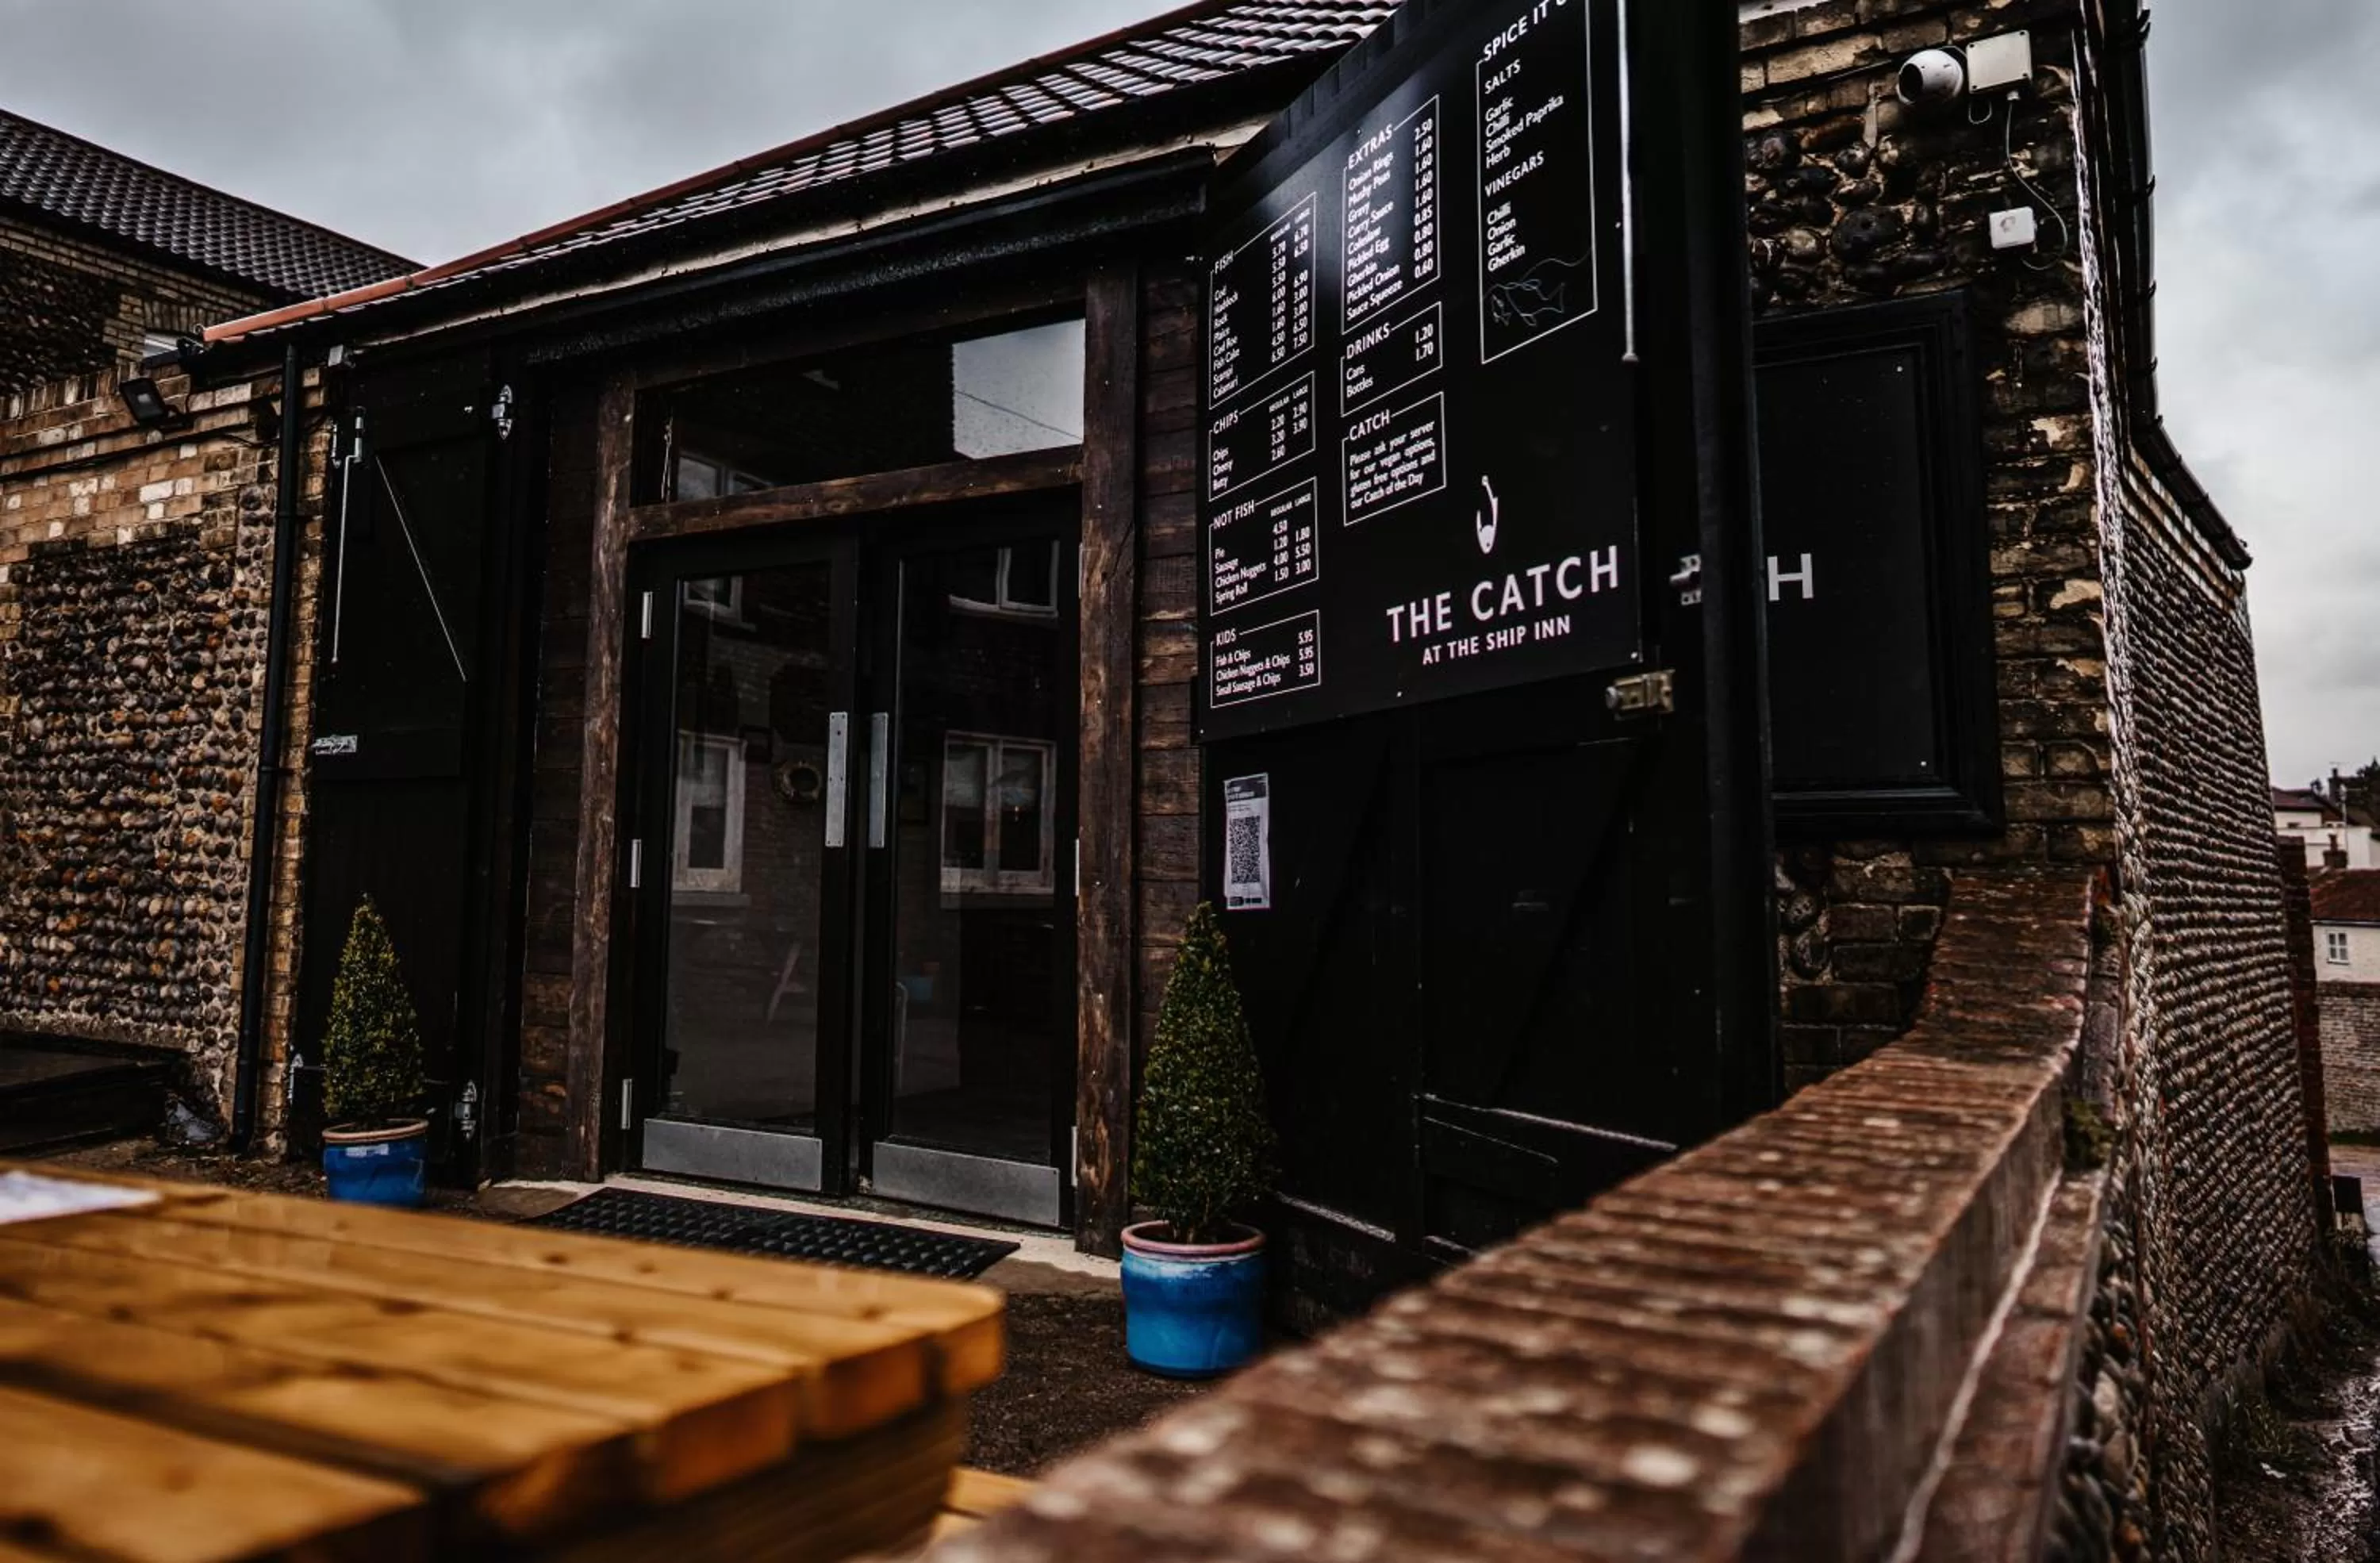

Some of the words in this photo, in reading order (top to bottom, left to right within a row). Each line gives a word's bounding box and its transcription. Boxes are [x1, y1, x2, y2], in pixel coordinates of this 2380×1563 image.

[1484, 15, 1528, 61] SPICE
[1533, 0, 1549, 25] IT
[1485, 59, 1520, 94] SALTS
[1485, 97, 1513, 122] Garlic
[1485, 113, 1509, 136] Chilli
[1486, 117, 1523, 153] Smoked
[1526, 95, 1564, 127] Paprika
[1348, 124, 1393, 170] EXTRAS
[1487, 144, 1511, 168] Herb
[1349, 168, 1372, 190] Onion
[1372, 152, 1393, 173] Rings
[1485, 151, 1544, 197] VINEGARS
[1349, 184, 1372, 208] Mushy
[1372, 171, 1390, 189] Peas
[1348, 217, 1369, 238] Curry
[1371, 202, 1393, 223] Sauce
[1349, 202, 1369, 222] Gravy
[1487, 202, 1511, 225] Chilli
[1348, 226, 1380, 255] Coleslaw
[1488, 219, 1515, 240] Onion
[1347, 244, 1374, 271] Pickled
[1376, 237, 1389, 253] Egg
[1488, 234, 1515, 255] Garlic
[1488, 245, 1525, 271] Gherkin
[1215, 249, 1234, 275] FISH
[1347, 262, 1377, 287] Gherkin
[1347, 278, 1373, 303] Pickled
[1375, 265, 1399, 286] Onion
[1347, 301, 1368, 321] Sauce
[1369, 280, 1403, 306] Squeeze
[1214, 341, 1225, 356] Cod
[1346, 323, 1390, 359] DRINKS
[1346, 365, 1365, 380] Cans
[1347, 377, 1372, 397] Bottles
[1213, 409, 1238, 435] CHIPS
[1349, 409, 1390, 441] CATCH
[1213, 447, 1228, 462] Chips
[1350, 451, 1371, 467] Please
[1374, 441, 1386, 455] ask
[1390, 434, 1407, 452] your
[1411, 421, 1434, 439] server
[1350, 470, 1361, 481] for
[1364, 463, 1376, 474] our
[1380, 452, 1401, 467] vegan
[1350, 479, 1371, 498] gluten
[1374, 473, 1388, 485] free
[1389, 460, 1418, 480] options
[1421, 449, 1435, 465] and
[1350, 497, 1363, 509] our
[1365, 487, 1384, 503] Catch
[1385, 482, 1393, 495] of
[1395, 477, 1407, 491] the
[1407, 473, 1423, 486] Day
[1213, 509, 1233, 530] NOT
[1235, 500, 1255, 520] FISH
[1215, 547, 1225, 559] Pie
[1215, 559, 1238, 574] Sausage
[1215, 573, 1239, 588] Chicken
[1241, 563, 1266, 579] Nuggets
[1215, 589, 1234, 605] Spring
[1236, 582, 1247, 595] Roll
[1386, 591, 1453, 643] THE
[1471, 544, 1619, 621] CATCH
[1216, 628, 1237, 647] KIDS
[1422, 645, 1441, 666] AT
[1446, 636, 1480, 661] THE
[1486, 624, 1526, 652] SHIP
[1534, 615, 1571, 640] INN
[1215, 654, 1226, 666] Fish
[1228, 652, 1233, 663] &
[1234, 649, 1250, 662] Chips
[1216, 668, 1239, 682] Chicken
[1238, 662, 1264, 676] Nuggets
[1265, 658, 1271, 669] &
[1272, 654, 1290, 668] Chips
[1216, 682, 1231, 697] Small
[1233, 681, 1255, 692] Sausage
[1257, 676, 1261, 687] &
[1263, 673, 1280, 685] Chips
